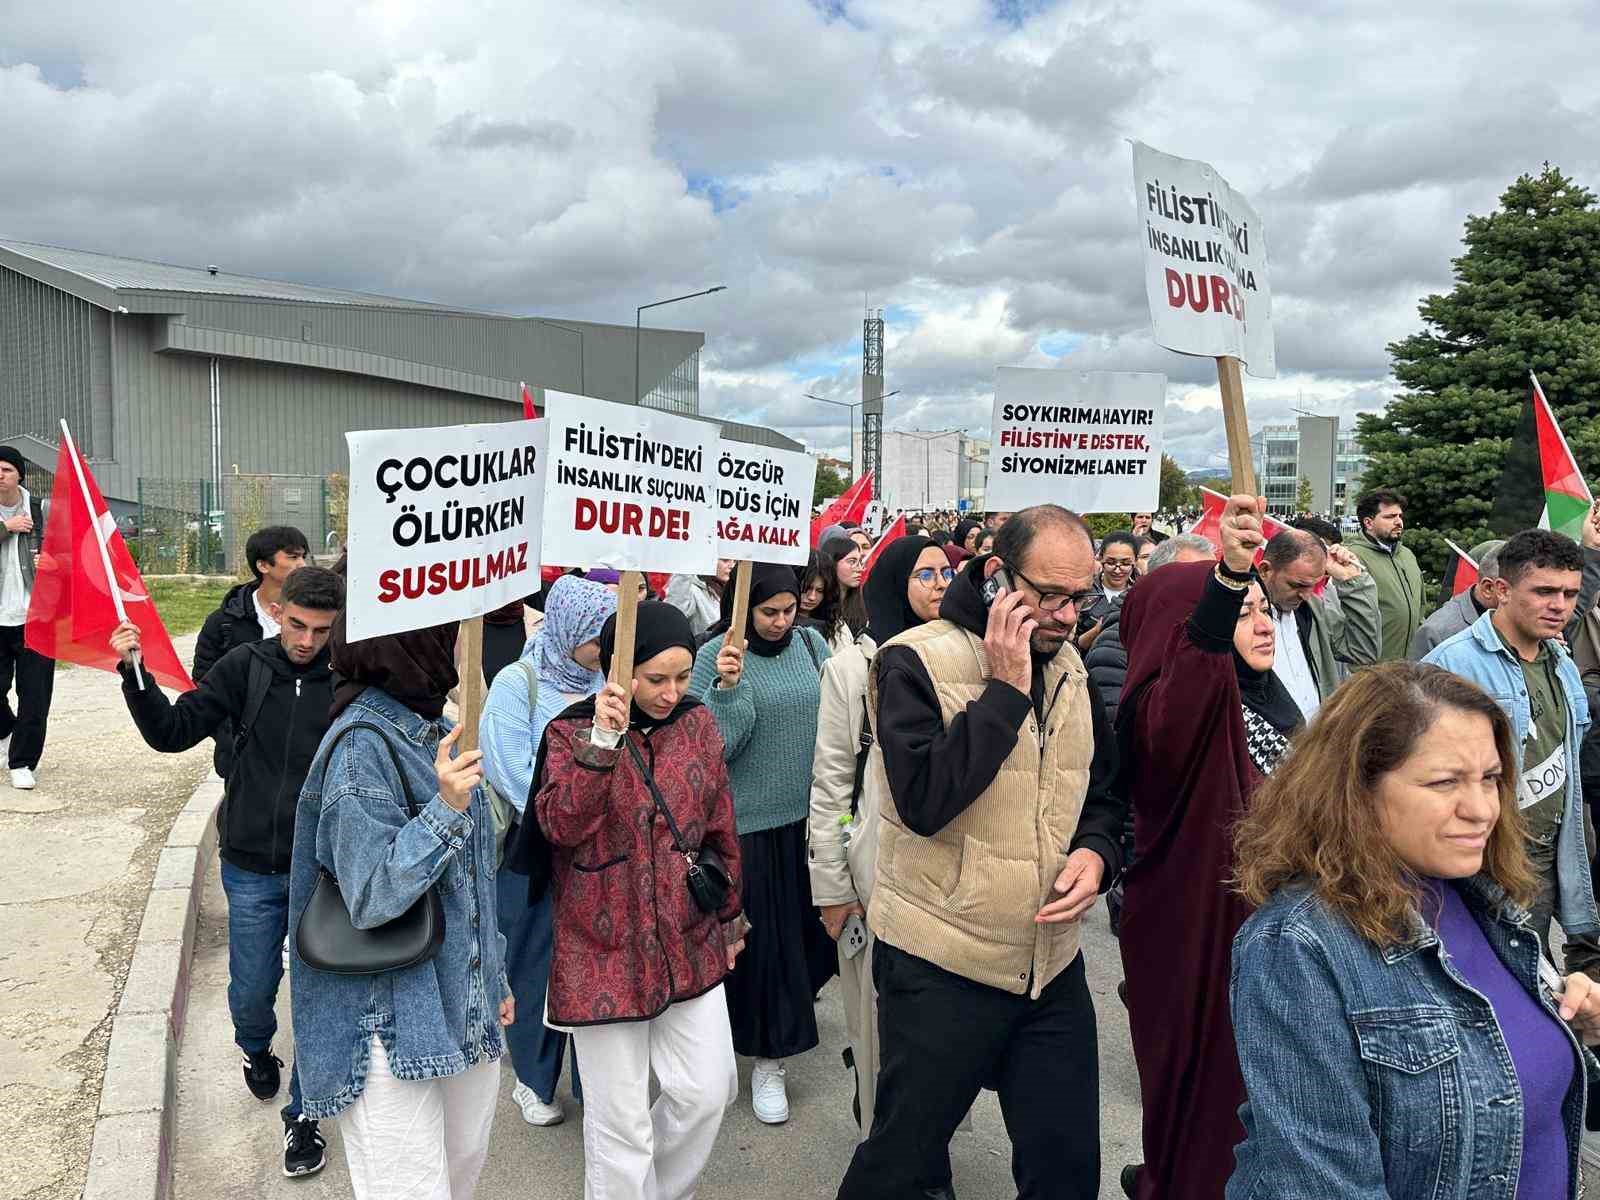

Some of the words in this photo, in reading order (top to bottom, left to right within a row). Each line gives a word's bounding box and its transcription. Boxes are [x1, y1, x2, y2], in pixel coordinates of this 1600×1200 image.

[1147, 220, 1224, 264] İNSANLIK
[1165, 268, 1233, 315] DUR
[1002, 404, 1100, 424] SOYKIRIMA
[1102, 408, 1153, 425] HAYIR!
[565, 422, 702, 472] FİLİSTİN'DEKİ
[1000, 426, 1088, 449] FİLİSTİN'E
[1091, 434, 1150, 453] DESTEK,
[376, 445, 536, 503] ÇOCUKLAR
[557, 459, 643, 494] İNSANLIK
[646, 477, 706, 503] SUÇUNA
[717, 452, 784, 485] ÖZGÜR
[1001, 452, 1096, 475] SİYONİZME
[393, 496, 525, 547] ÖLÜRKEN
[575, 497, 643, 536] DUR
[648, 506, 690, 541] DE!
[716, 487, 761, 513] DÜS
[765, 490, 800, 520] İÇİN
[758, 525, 801, 547] KALK
[377, 542, 529, 604] SUSULMAZ
